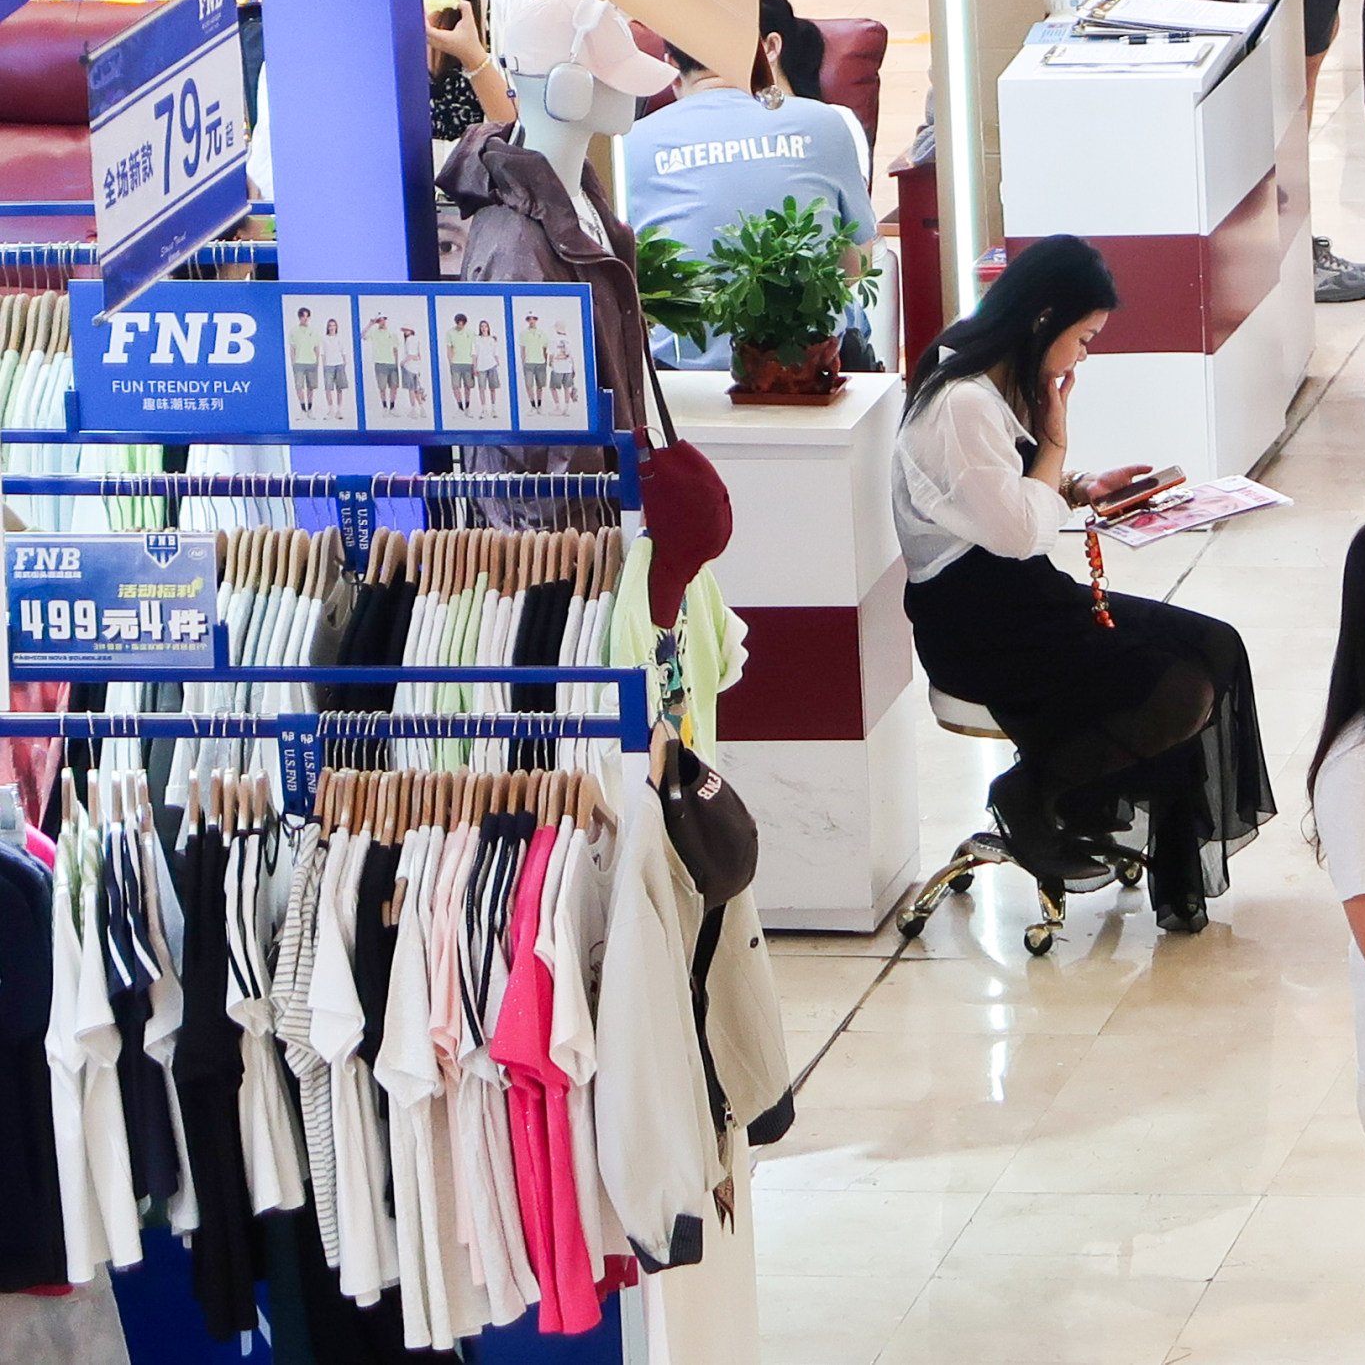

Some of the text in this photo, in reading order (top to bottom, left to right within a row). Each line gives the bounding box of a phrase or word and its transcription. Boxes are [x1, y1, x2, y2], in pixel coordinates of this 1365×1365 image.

[103, 140, 155, 210] 全场新款
[102, 312, 257, 364] FNB
[112, 380, 251, 393] FUN TRENDY PLAY
[142, 397, 224, 412] 趣味潮玩系列
[149, 535, 177, 546] FNB
[13, 547, 82, 571] FNB
[117, 584, 197, 599] 活动福利
[20, 599, 209, 642] 499元4件
[696, 770, 722, 801] FNB
